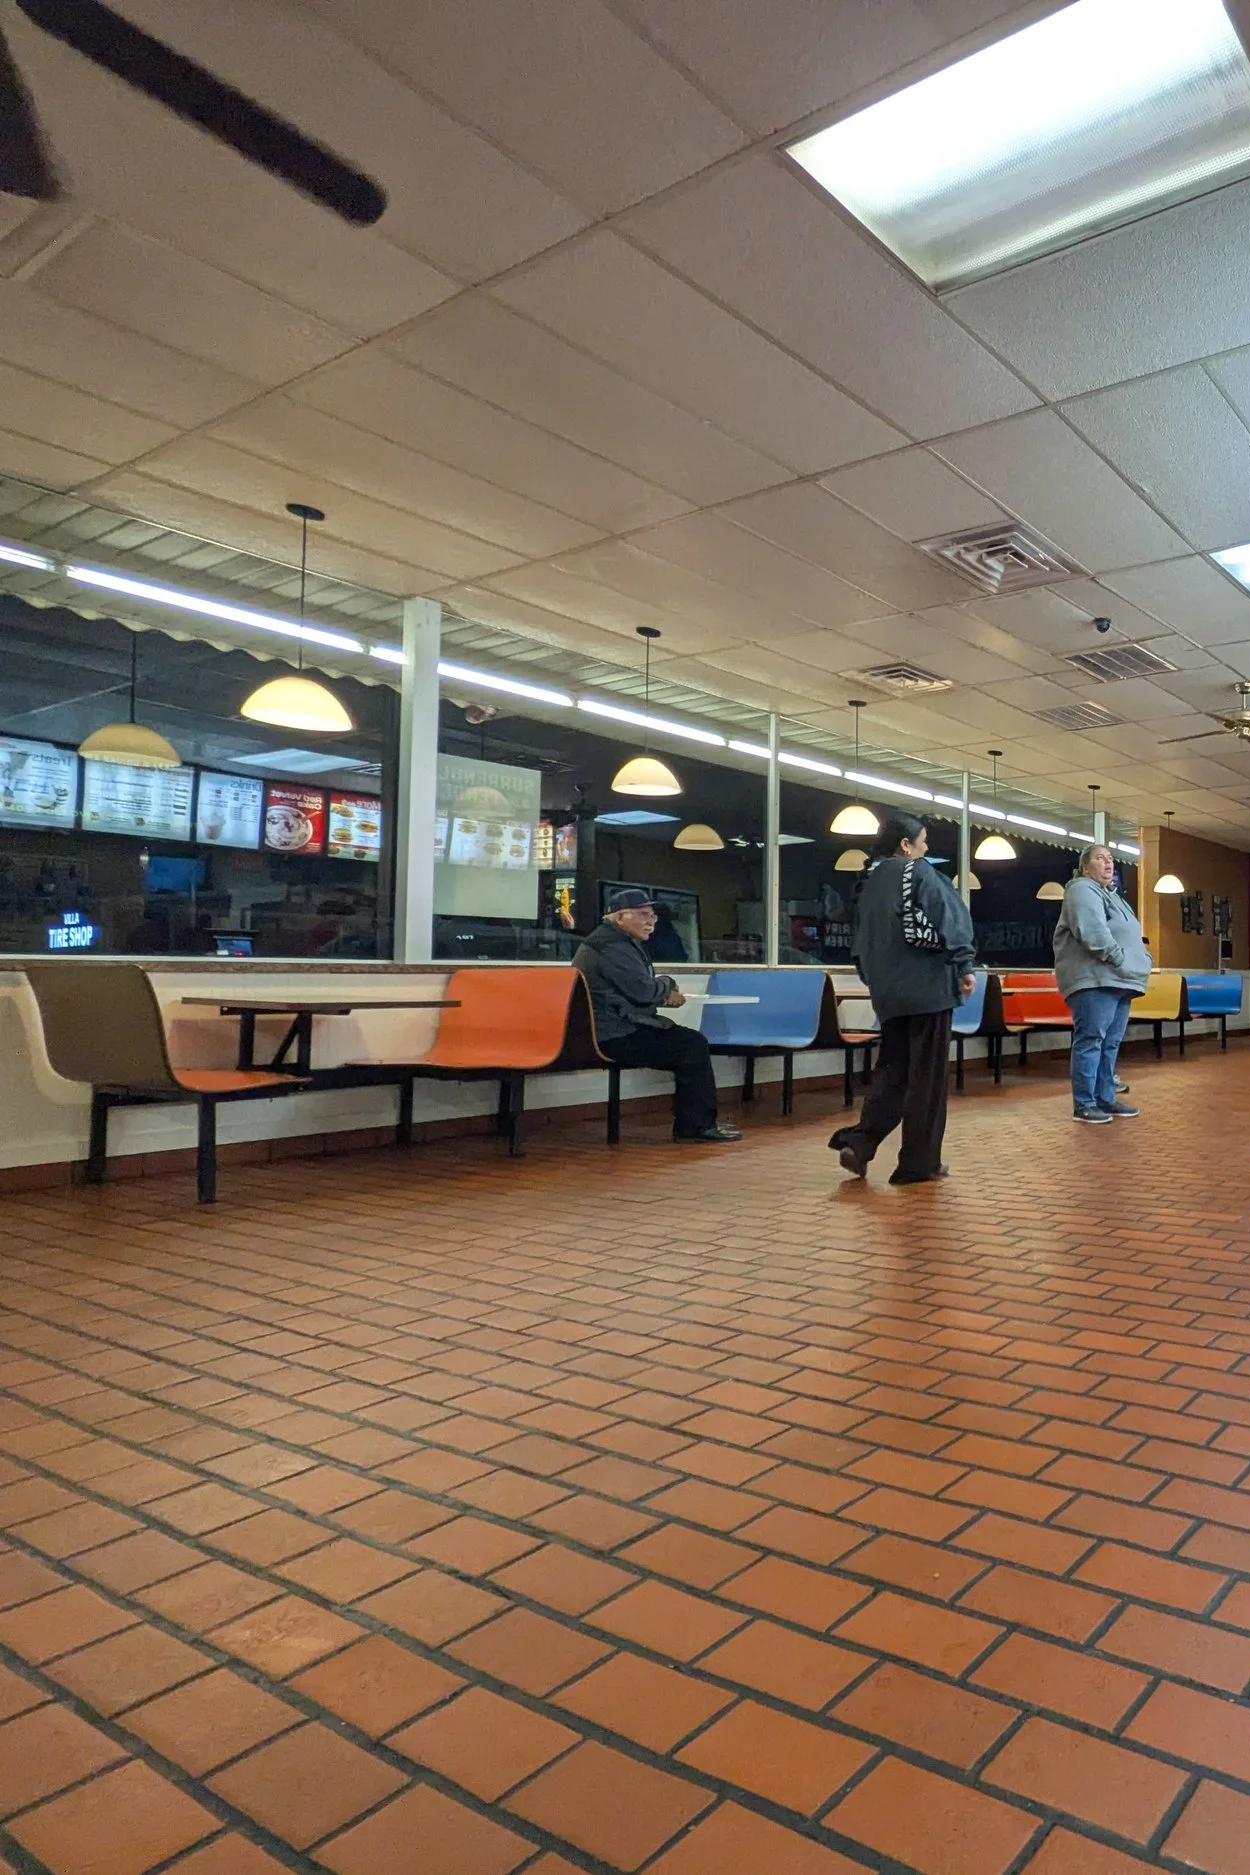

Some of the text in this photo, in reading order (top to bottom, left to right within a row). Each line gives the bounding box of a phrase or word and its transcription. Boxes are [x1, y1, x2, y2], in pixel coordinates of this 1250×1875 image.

[63, 912, 80, 925] VILLA
[48, 925, 93, 949] TIRE SHOP
